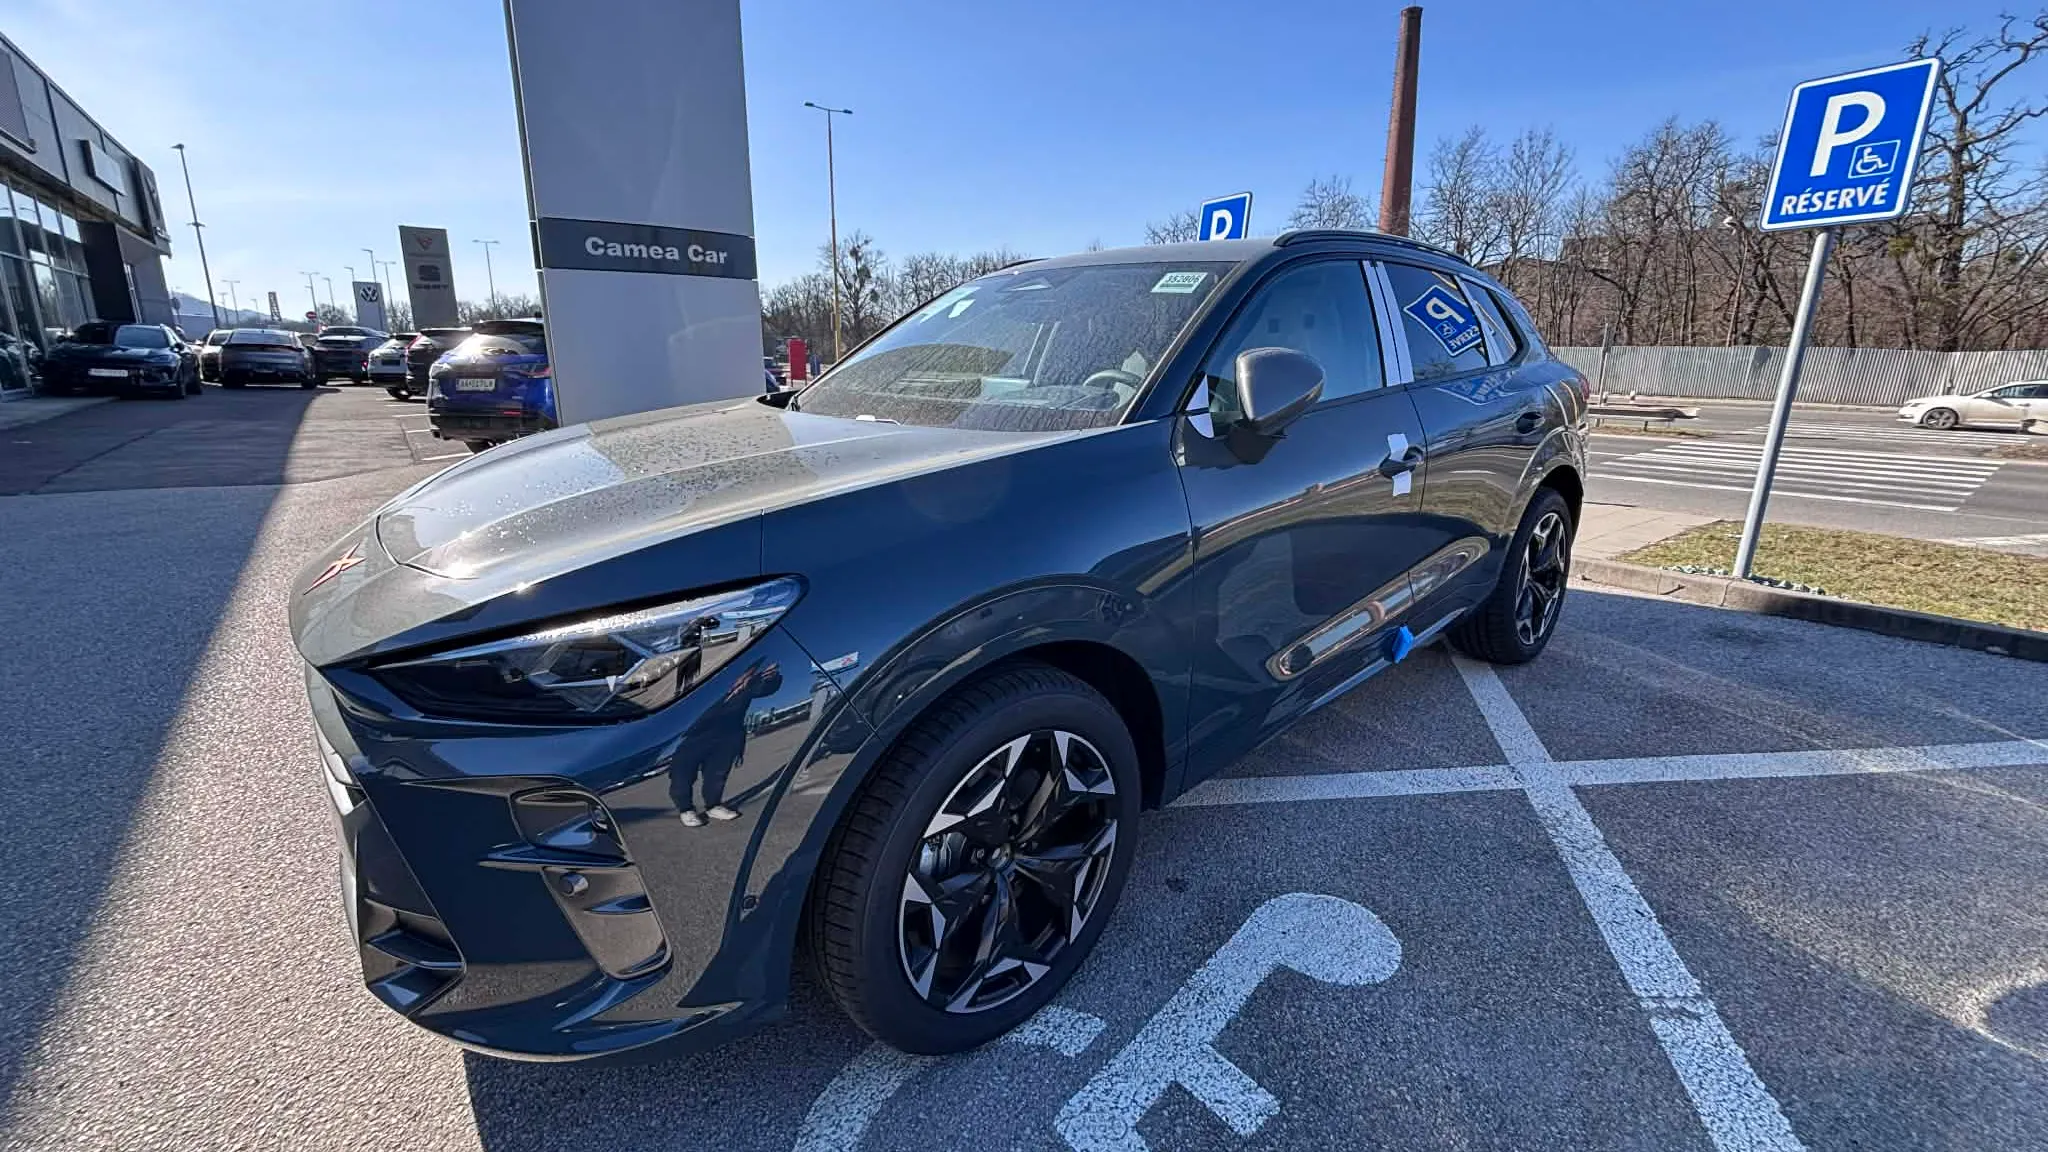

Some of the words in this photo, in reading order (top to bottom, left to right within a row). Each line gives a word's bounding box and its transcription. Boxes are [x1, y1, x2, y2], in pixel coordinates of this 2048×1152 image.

[1810, 91, 1886, 177] P
[1780, 177, 1891, 215] RÉSERVÉ
[584, 236, 680, 260] Camea
[687, 244, 728, 264] Car
